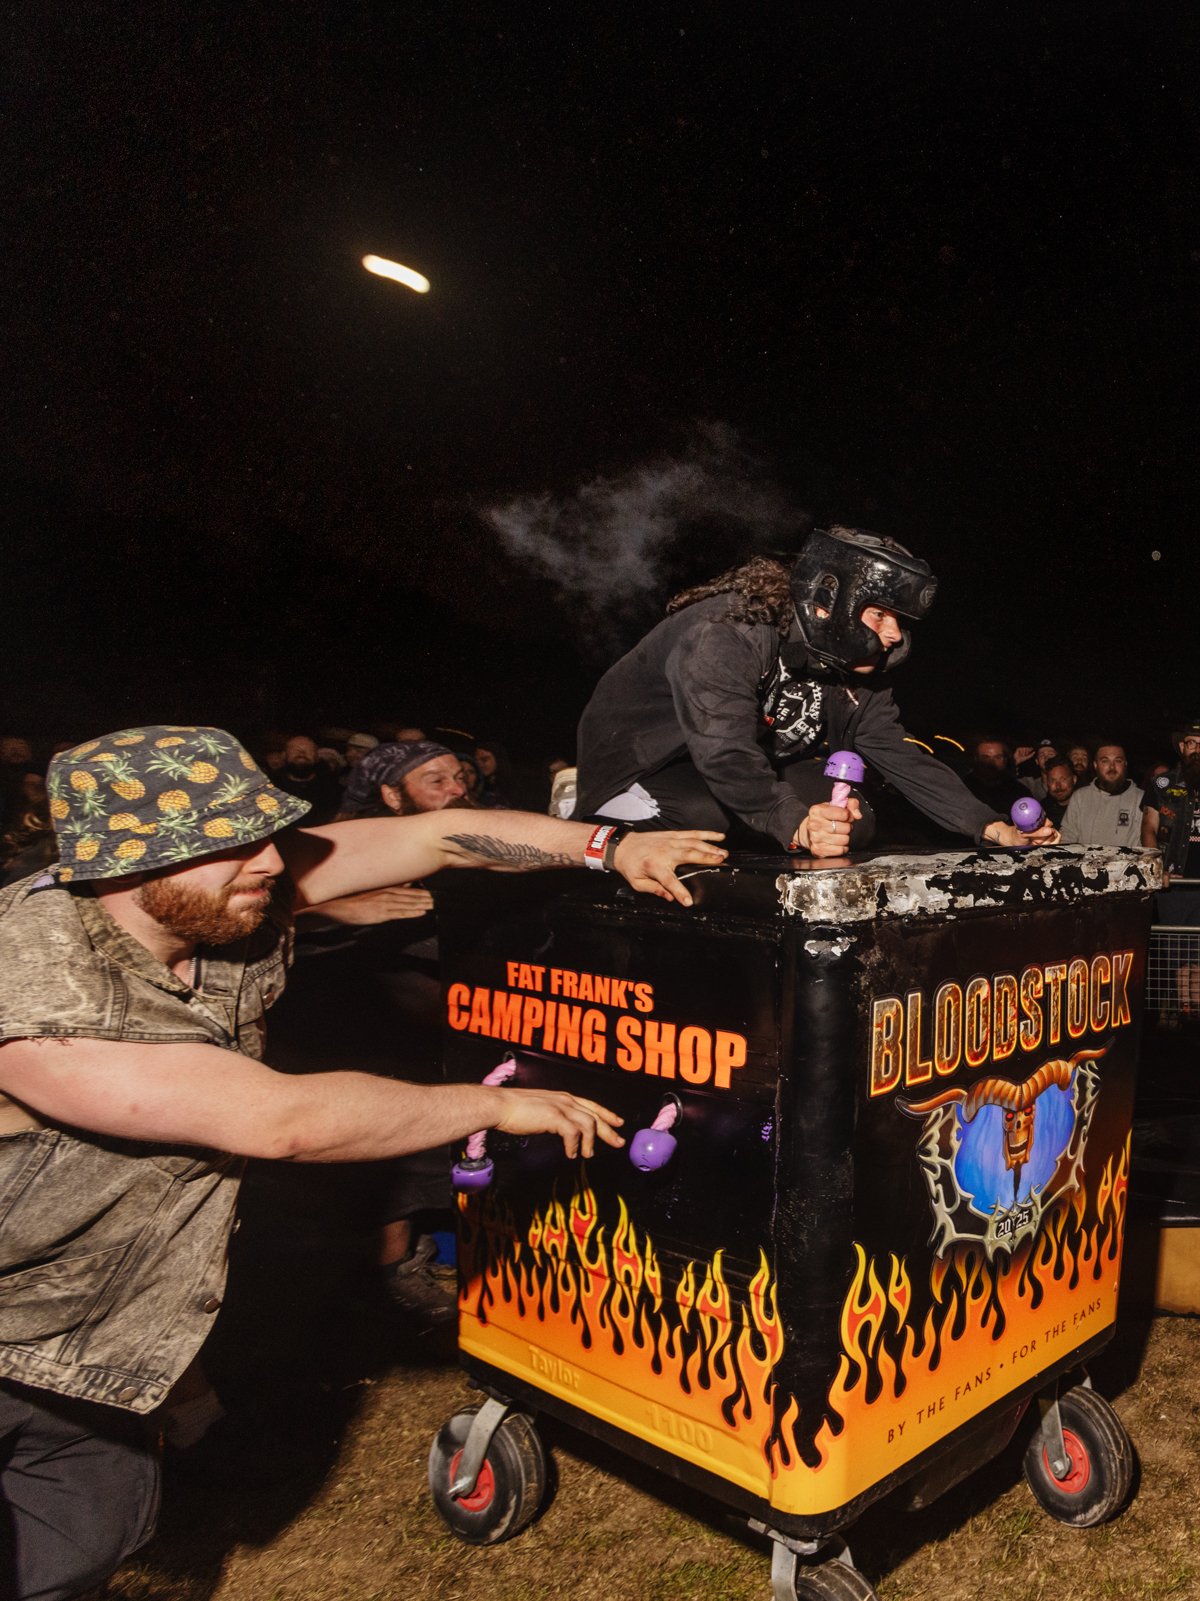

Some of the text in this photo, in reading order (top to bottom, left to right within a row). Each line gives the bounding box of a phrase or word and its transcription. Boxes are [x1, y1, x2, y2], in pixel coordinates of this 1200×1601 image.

[506, 961, 655, 1013] FAT FRANK'S
[870, 953, 1134, 1098] BLOODSTOCK
[447, 982, 748, 1090] CAMPING SHOP
[529, 1345, 581, 1389] Taylor
[887, 1298, 1102, 1444] BY THE FANS FOR THE FANS
[645, 1404, 713, 1454] 1100
